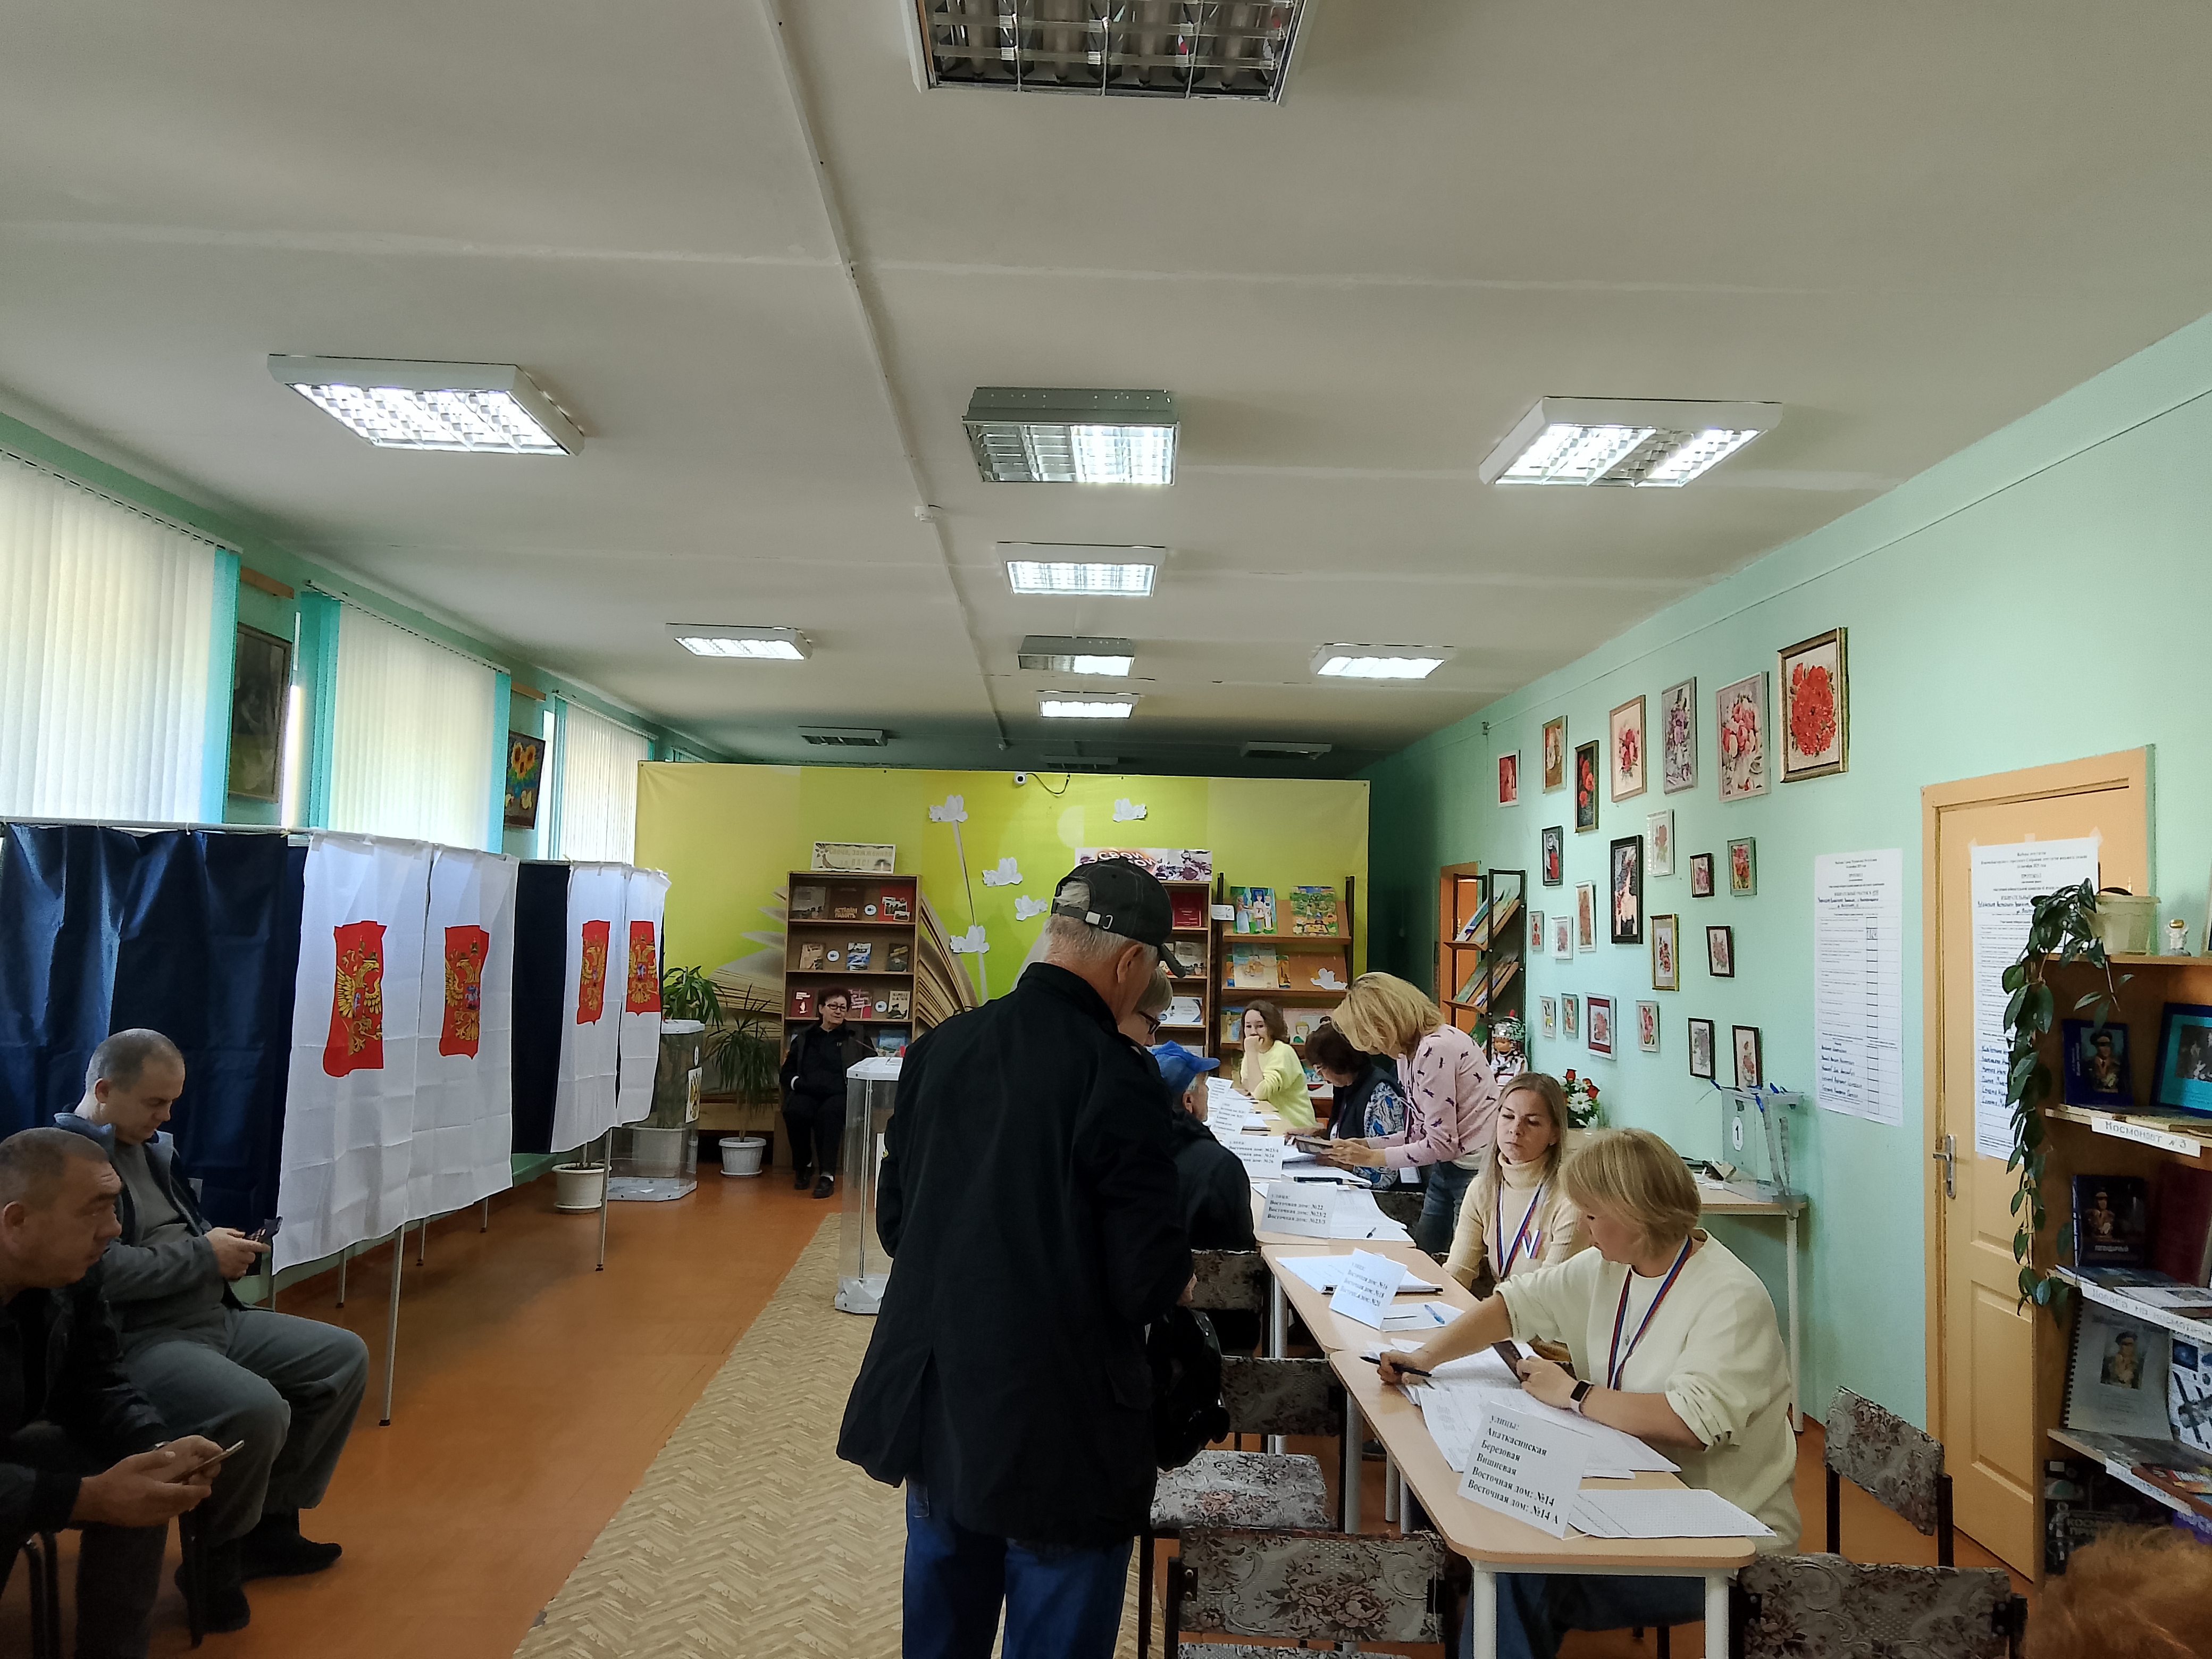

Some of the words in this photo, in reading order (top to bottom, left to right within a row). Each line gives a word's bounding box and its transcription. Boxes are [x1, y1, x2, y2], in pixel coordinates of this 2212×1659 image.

[1735, 1125, 1739, 1141] 1
[1489, 1415, 1520, 1430] улицы:
[1481, 1439, 1521, 1462] Березовая
[1487, 1428, 1547, 1456] Анаткасинская
[1477, 1453, 1517, 1476] Вишневая
[1472, 1466, 1513, 1490] Восточная
[1514, 1486, 1534, 1498] дом:
[1534, 1492, 1555, 1507] №14
[1468, 1479, 1509, 1504] Восточная
[1511, 1499, 1529, 1512] дом:
[1530, 1505, 1551, 1521] №14
[1552, 1514, 1558, 1524] А
